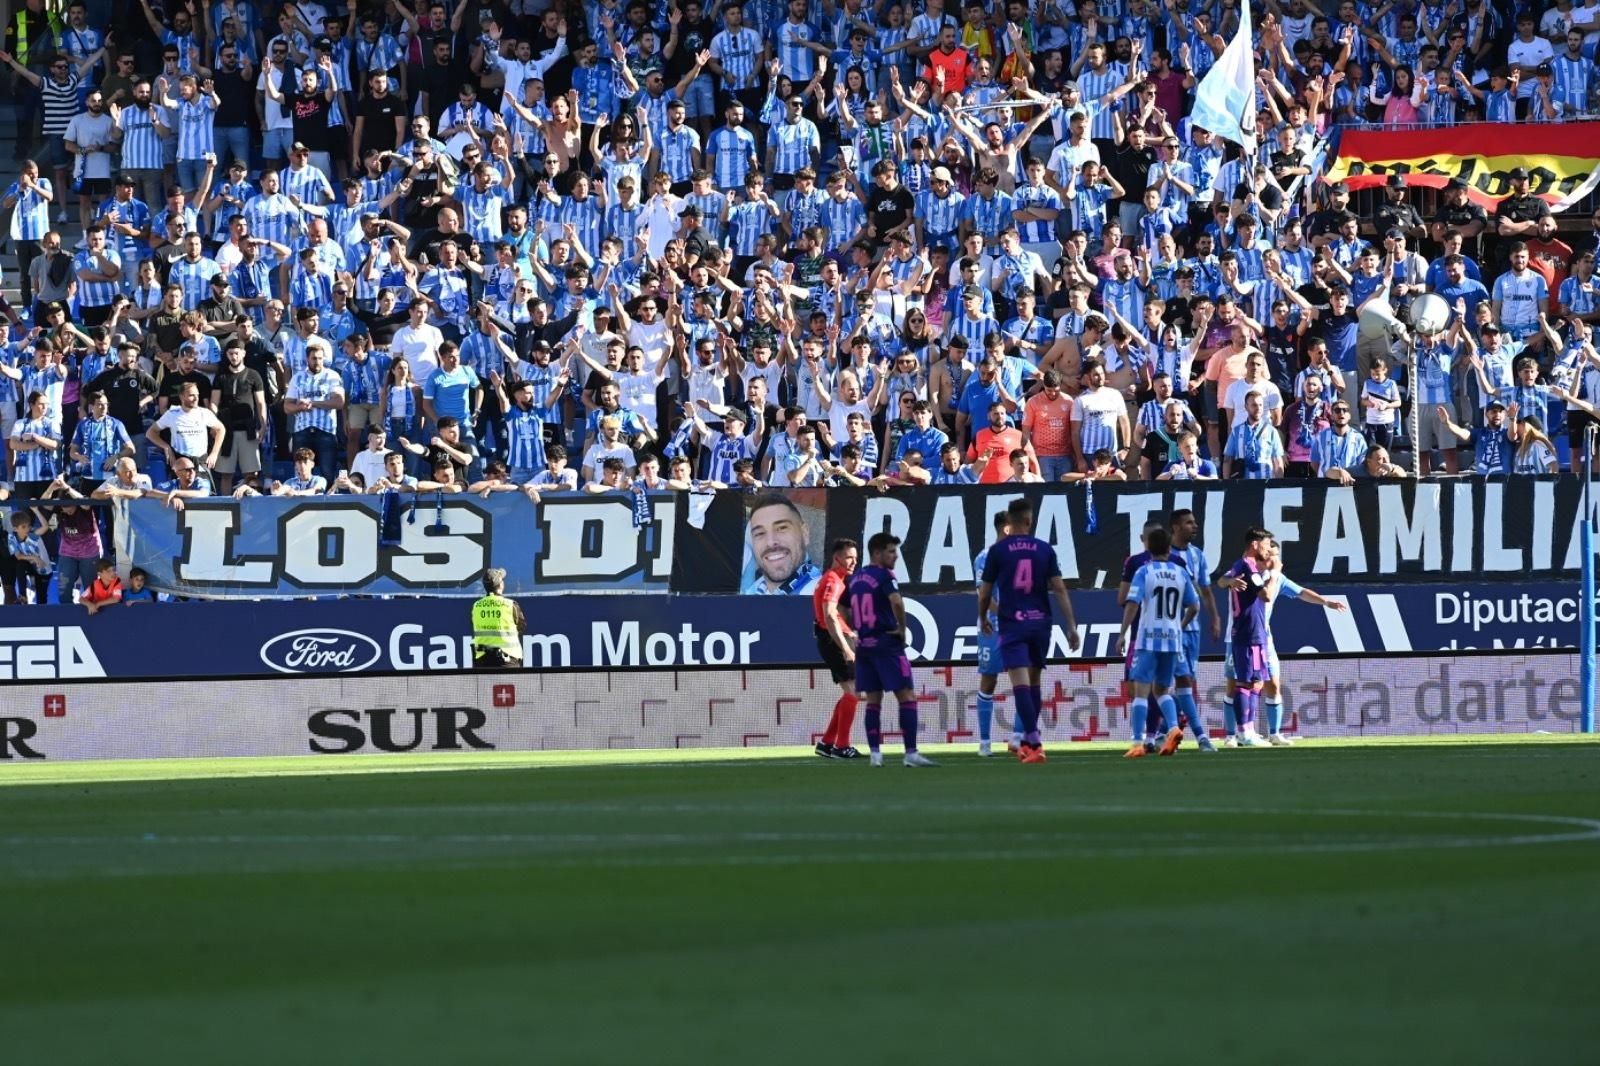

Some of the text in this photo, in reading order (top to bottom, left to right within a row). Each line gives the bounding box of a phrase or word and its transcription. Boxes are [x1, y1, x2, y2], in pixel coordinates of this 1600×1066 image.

[177, 504, 489, 585] LOS
[1116, 490, 1225, 577] TU
[1013, 558, 1033, 594] 4
[480, 610, 501, 619] 0119
[850, 592, 877, 631] 14
[1151, 585, 1180, 620] 10
[290, 635, 356, 668] Ford
[388, 620, 761, 671] Gam Motor
[1415, 663, 1581, 732] darte
[308, 706, 496, 754] SUR
